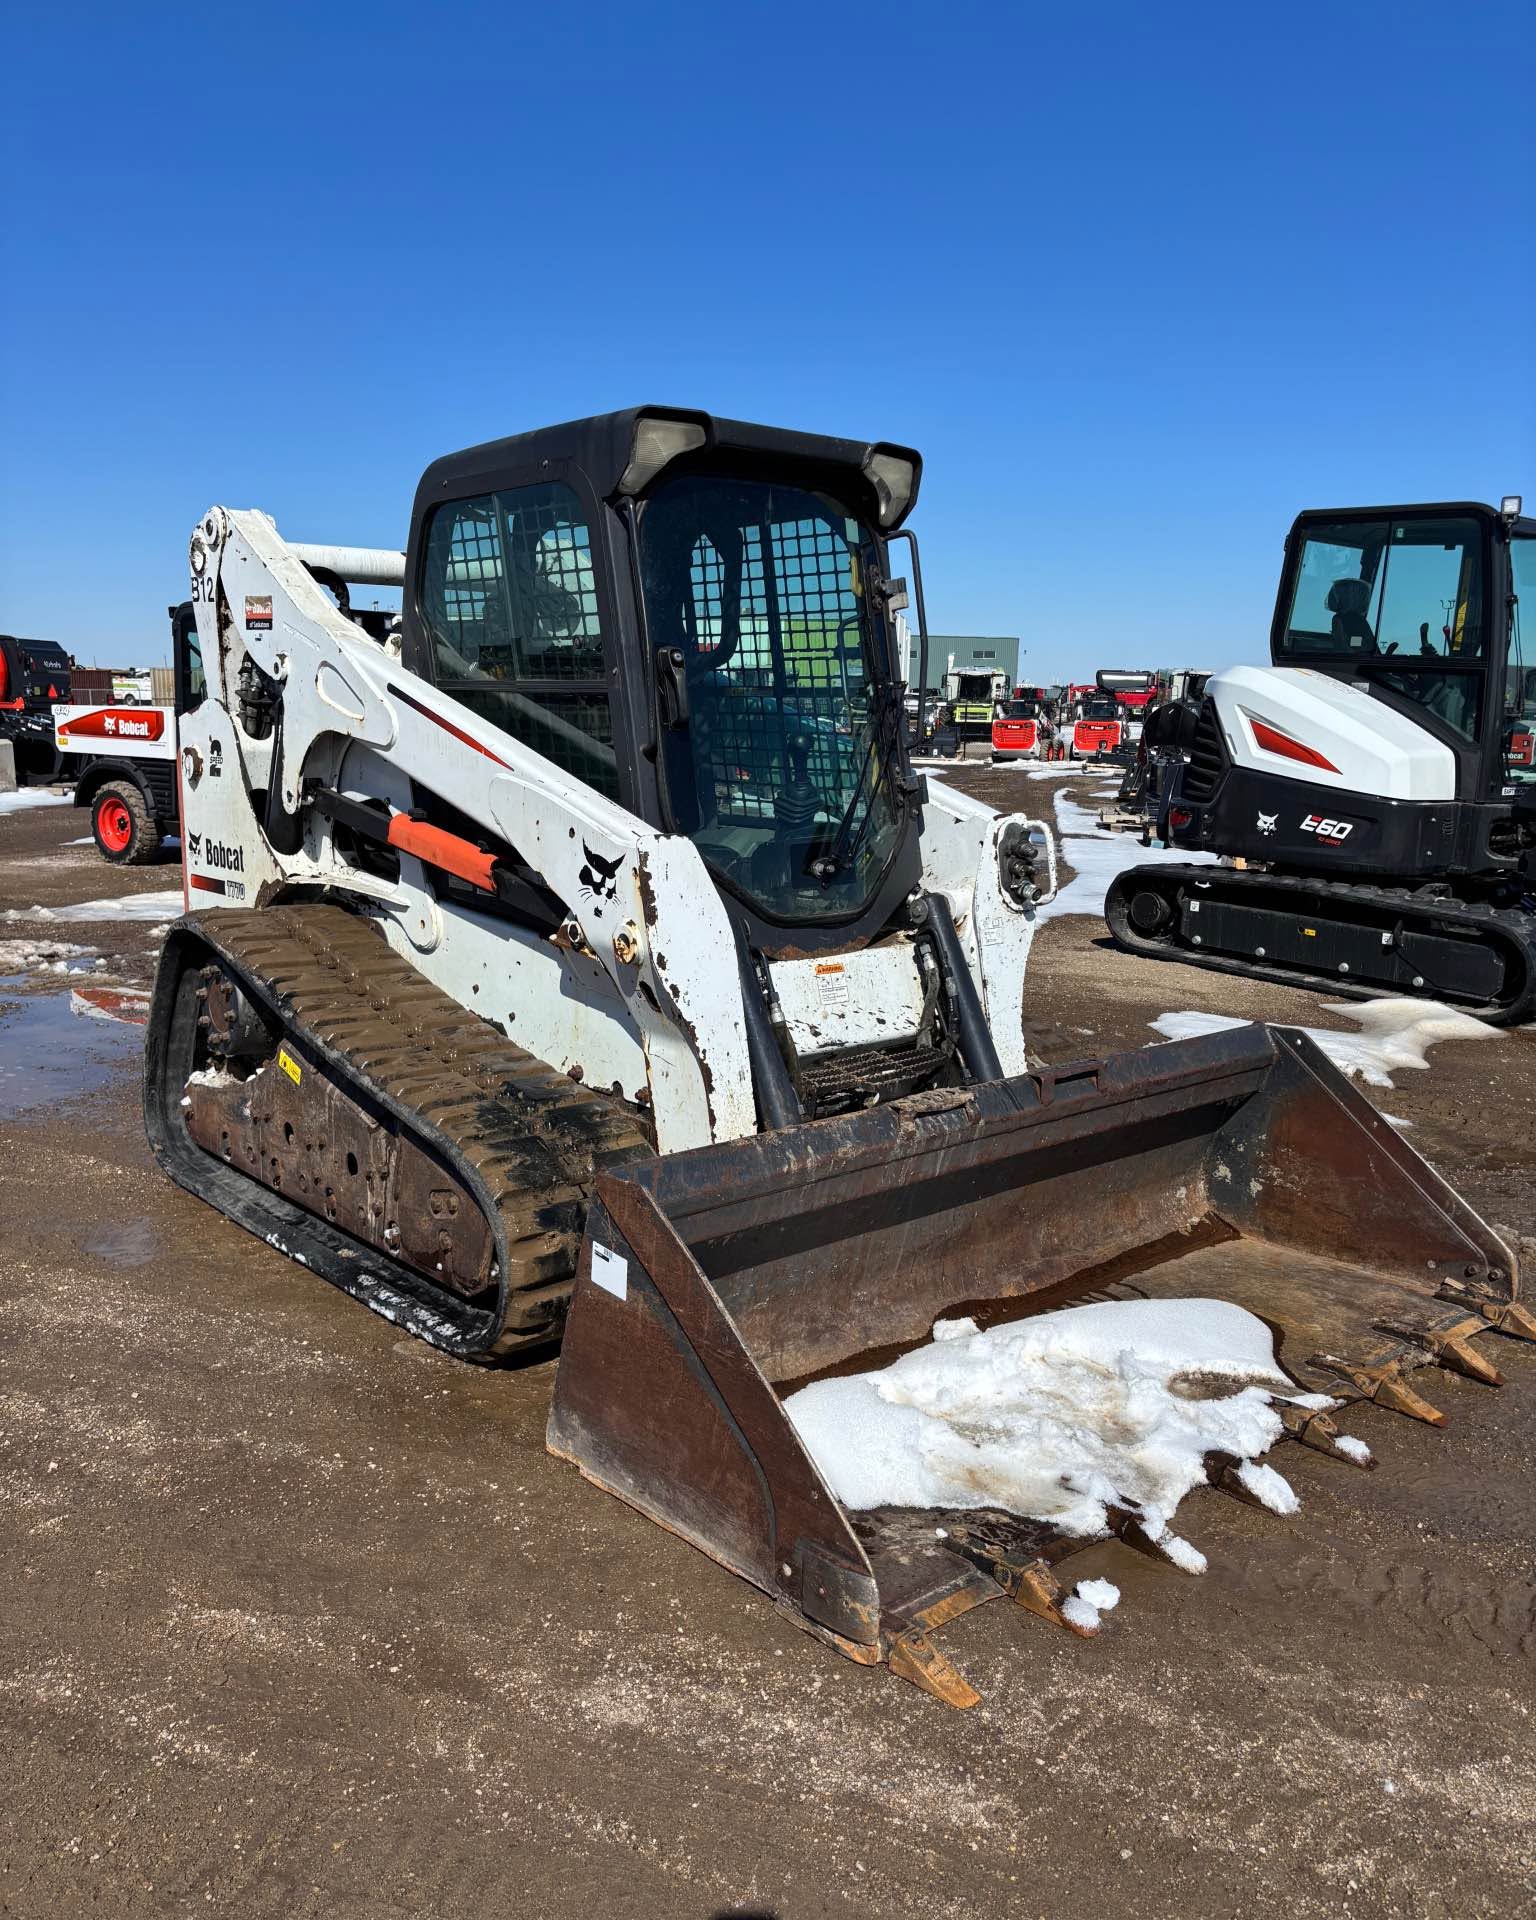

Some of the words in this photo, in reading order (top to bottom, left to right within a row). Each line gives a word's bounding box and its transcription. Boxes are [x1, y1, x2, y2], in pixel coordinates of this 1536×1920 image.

[118, 720, 150, 736] Bobcat
[210, 756, 223, 764] SPEED
[1299, 814, 1353, 840] E60
[205, 838, 245, 873] Bobcat
[226, 880, 246, 901] T770
